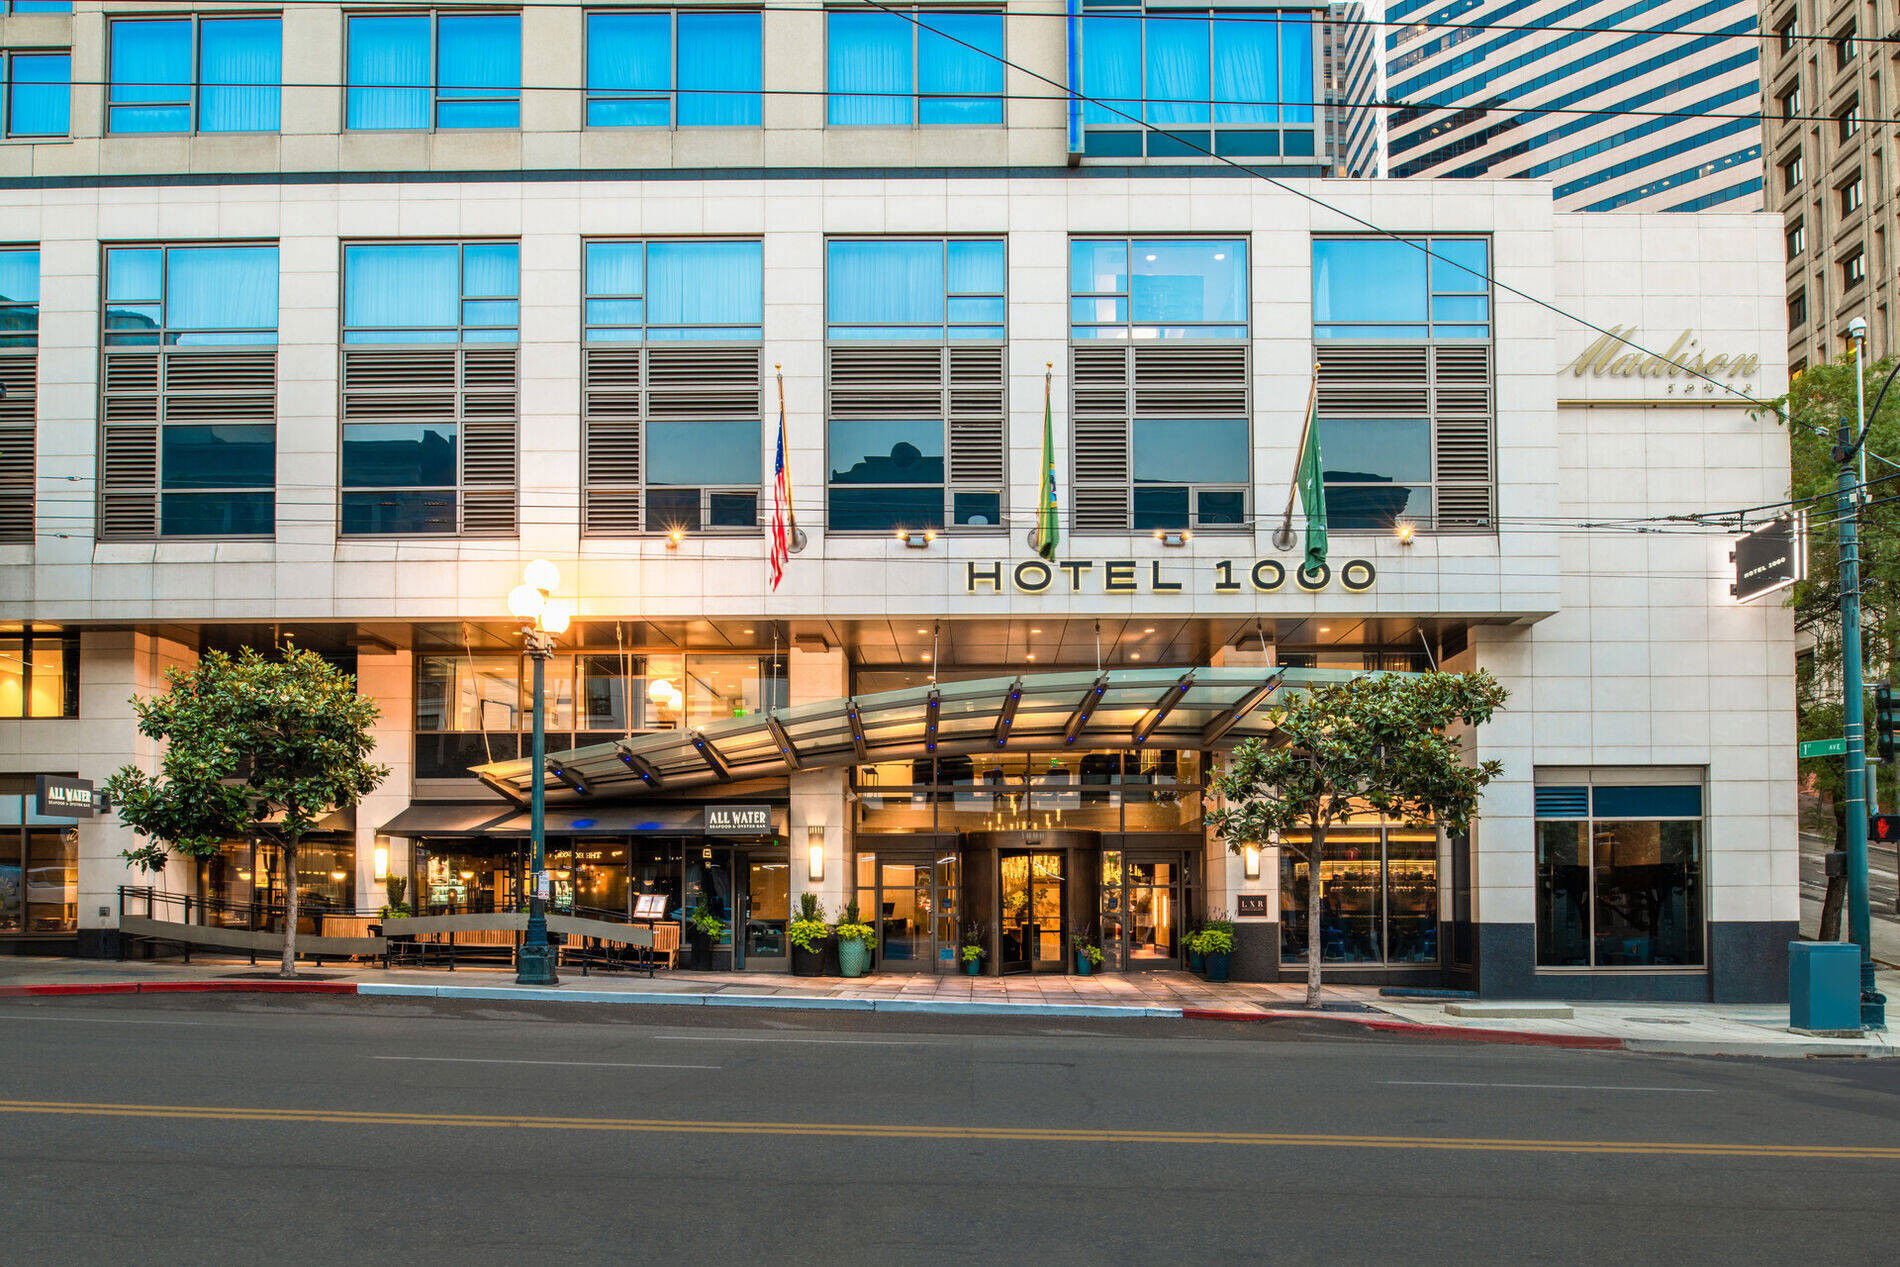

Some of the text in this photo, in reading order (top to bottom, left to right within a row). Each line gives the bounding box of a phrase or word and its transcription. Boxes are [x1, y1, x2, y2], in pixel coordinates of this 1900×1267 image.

[1556, 323, 1761, 379] Madison
[967, 559, 1376, 592] HOTEL 1000
[1744, 557, 1786, 578] HOTEL 1000
[1829, 743, 1841, 751] AVE
[48, 786, 92, 802] ALL WATER
[710, 811, 766, 824] ALL WATER
